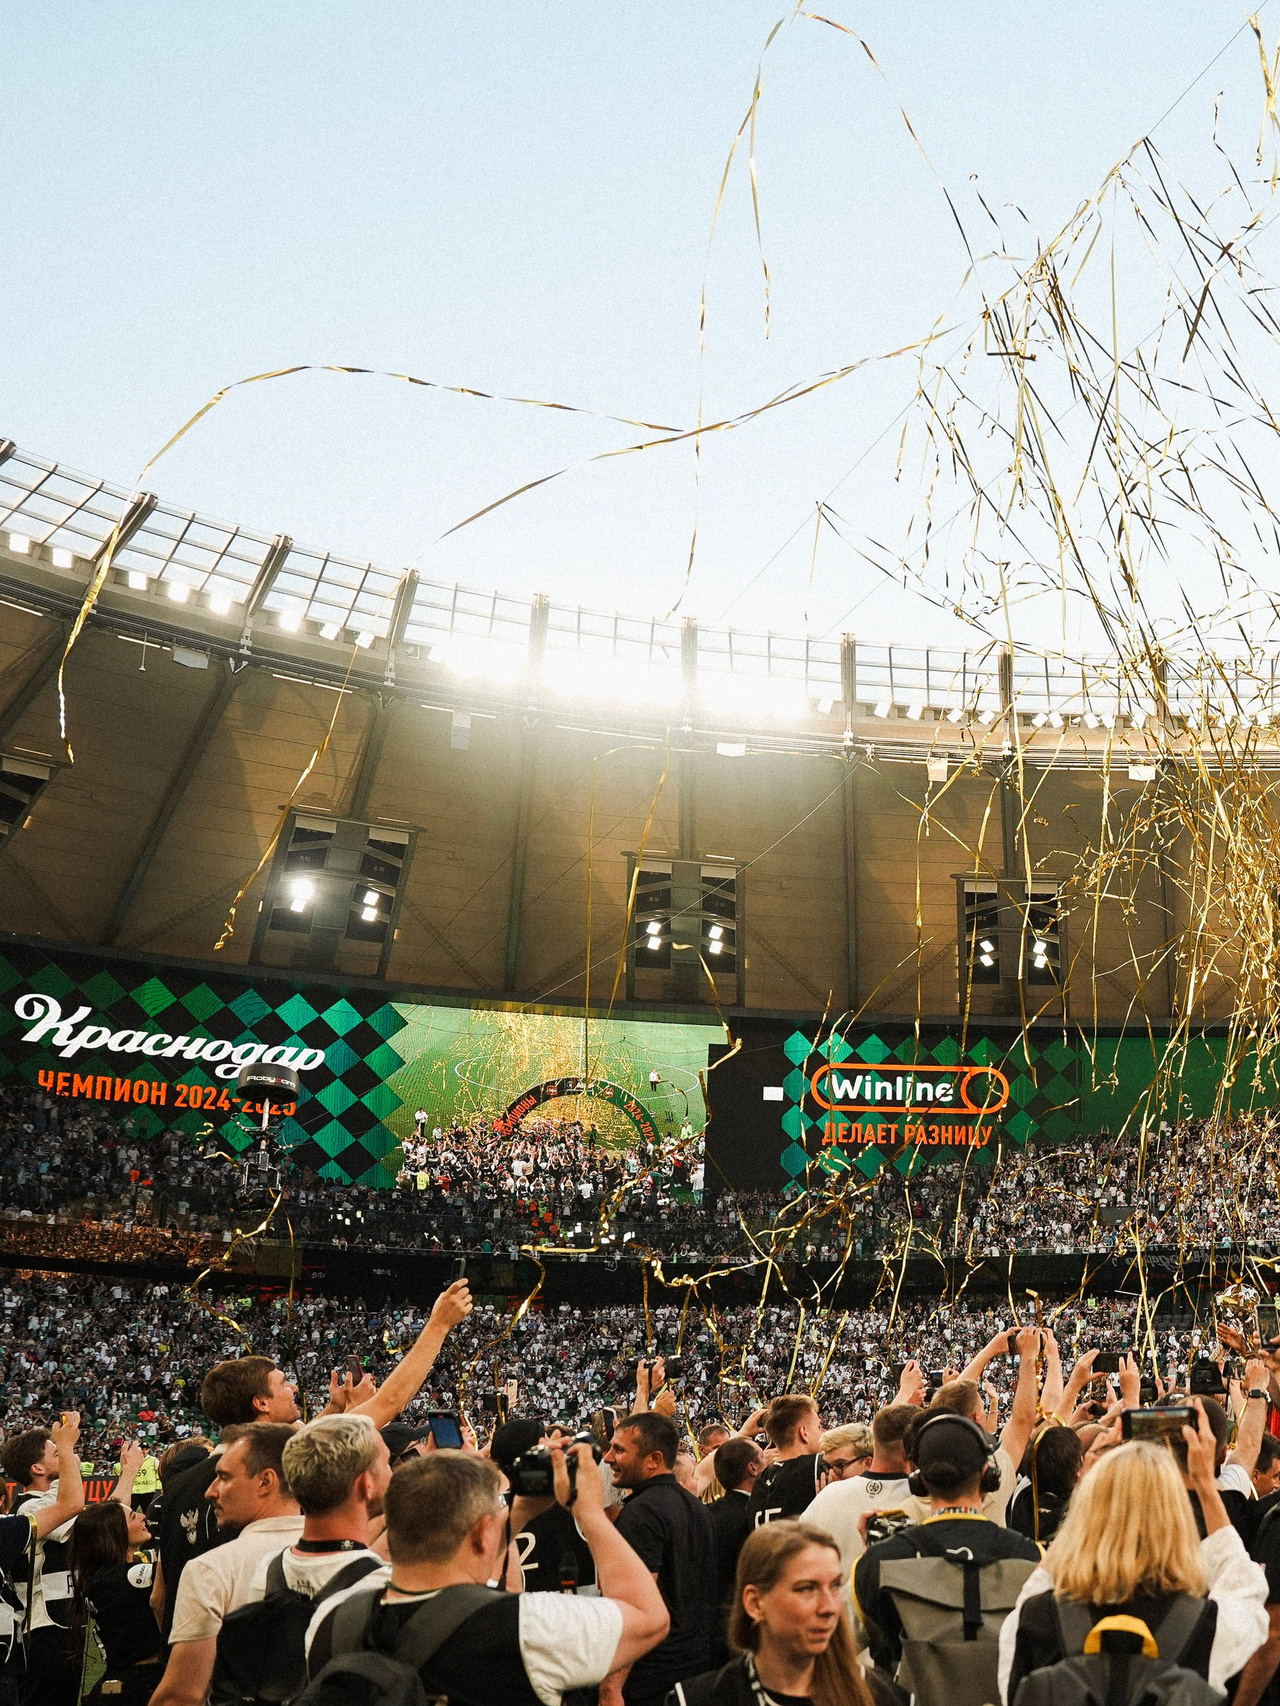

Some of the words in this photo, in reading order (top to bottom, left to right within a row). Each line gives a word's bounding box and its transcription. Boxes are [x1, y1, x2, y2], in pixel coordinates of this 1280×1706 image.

[14, 993, 326, 1080] Краснодар
[38, 1069, 168, 1106] ЧЕМПИОН
[831, 1074, 954, 1102] Winline
[821, 1122, 899, 1146] ДЕЛАЕТ
[904, 1123, 993, 1149] РАЗНИЦУ
